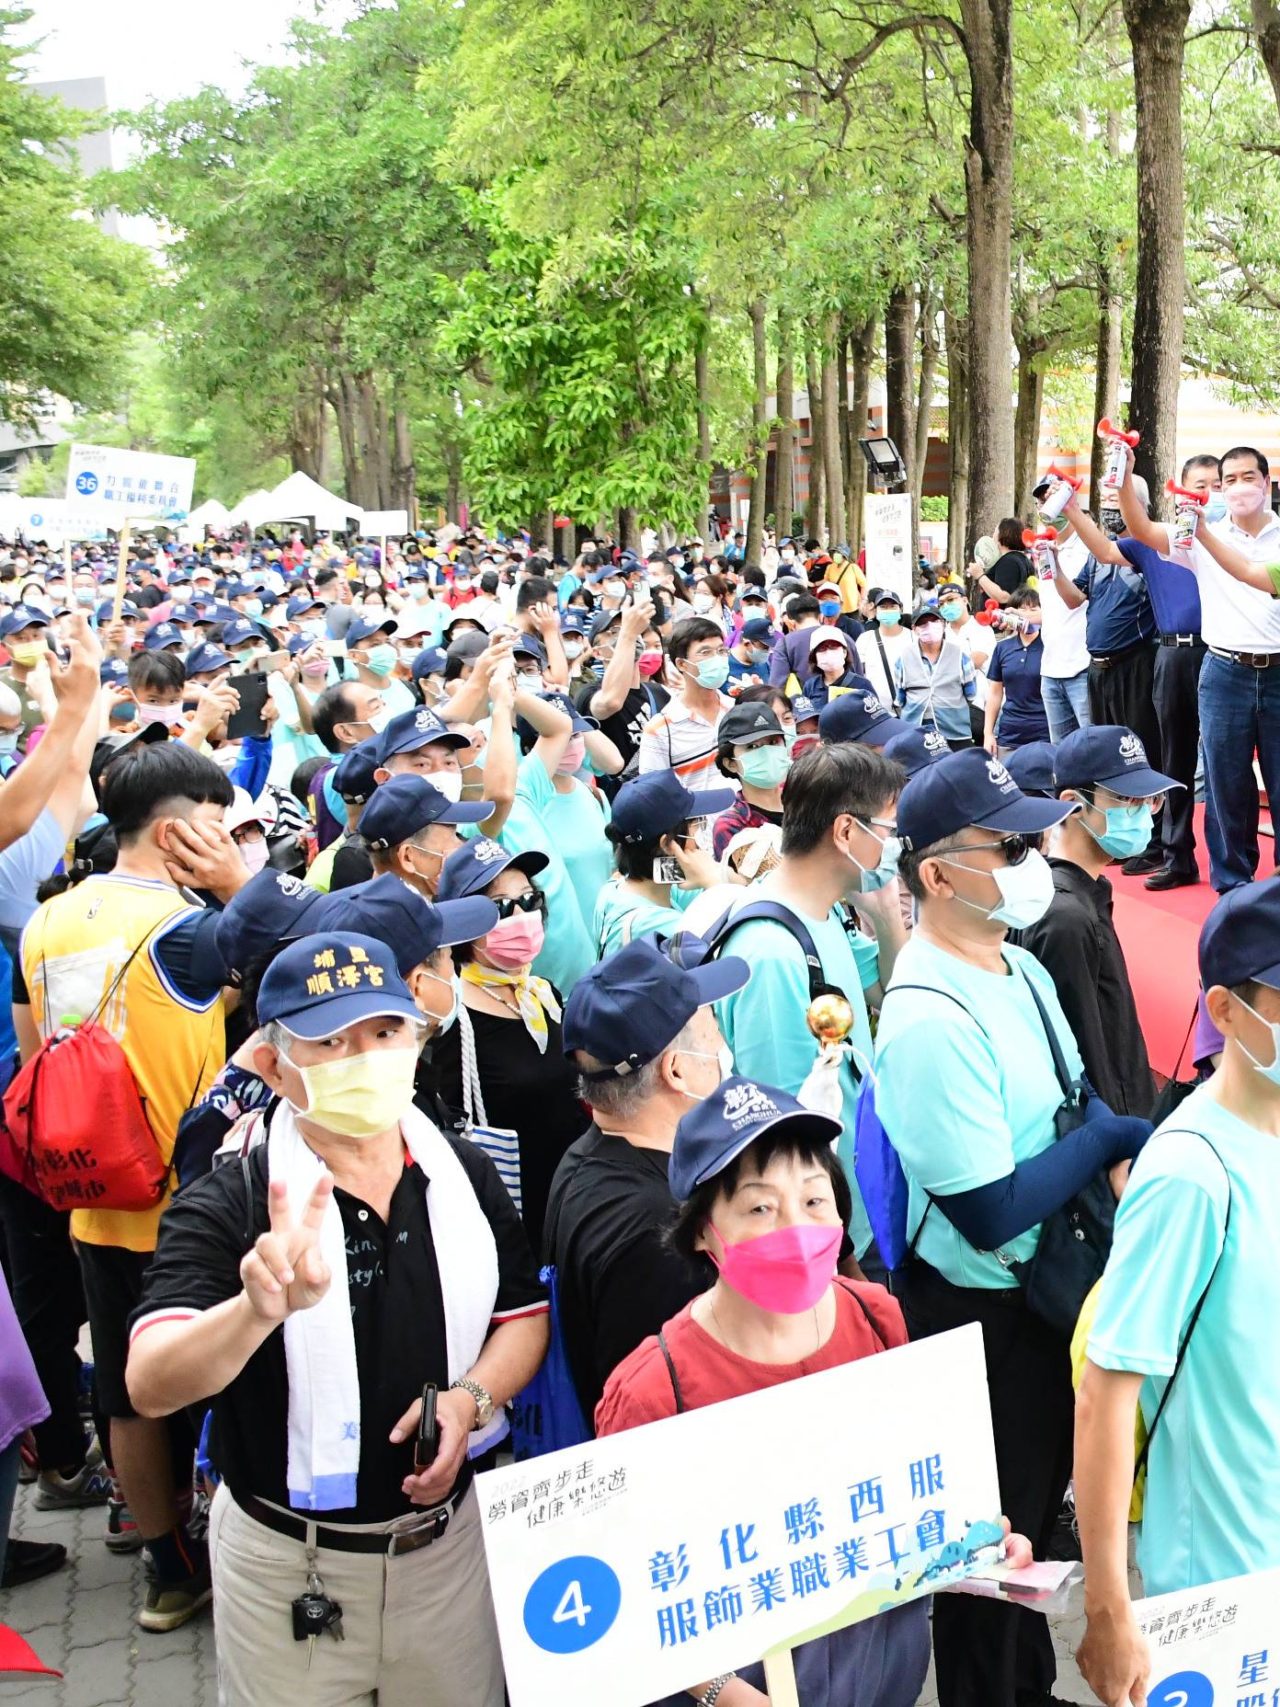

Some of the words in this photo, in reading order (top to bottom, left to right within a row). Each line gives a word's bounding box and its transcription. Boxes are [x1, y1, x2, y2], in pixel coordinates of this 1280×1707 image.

[77, 476, 97, 491] 36
[488, 1459, 595, 1525] 勞資齊步走
[527, 1466, 626, 1529] 健康樂悠遊
[648, 1453, 945, 1593] 彰化縣西服
[552, 1580, 592, 1627] 4
[656, 1508, 947, 1650] 服飾業職業工會
[1158, 1604, 1239, 1648] 健康樂悠遊
